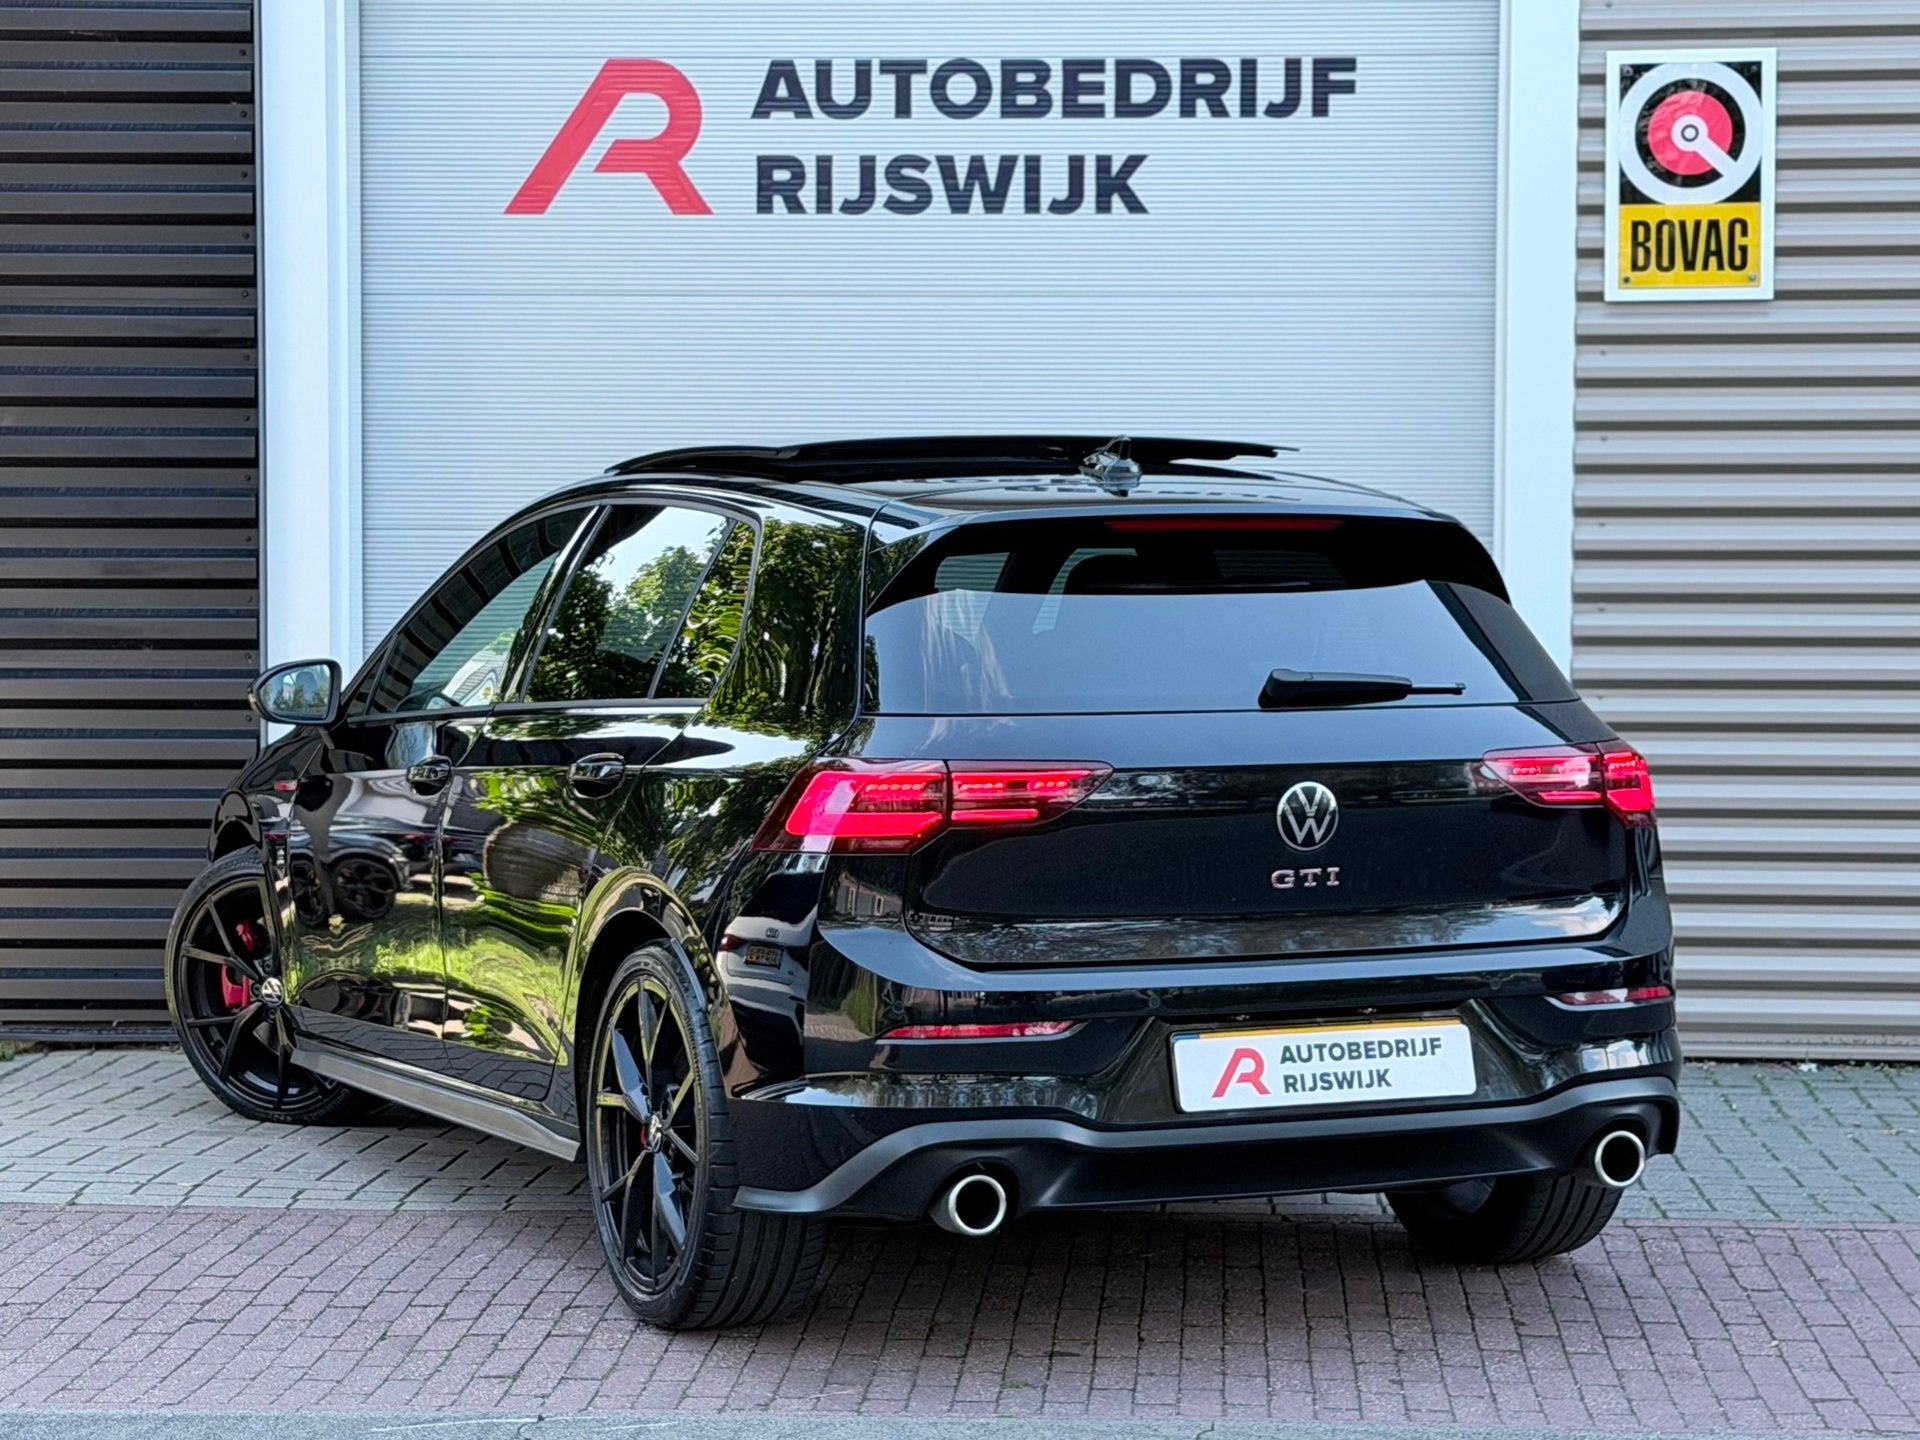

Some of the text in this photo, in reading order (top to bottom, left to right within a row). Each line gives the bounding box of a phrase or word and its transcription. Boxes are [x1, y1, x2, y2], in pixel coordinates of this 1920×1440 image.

[751, 57, 1357, 119] AUTOBEDRIJF
[756, 154, 1149, 215] RIJSWIJK
[1630, 218, 1749, 273] BOVAG
[1278, 783, 1338, 850] VW
[1271, 867, 1340, 889] GTI
[1279, 1037, 1443, 1065] AUTOBEDRIJF
[1283, 1068, 1392, 1093] RIJSWIJK
